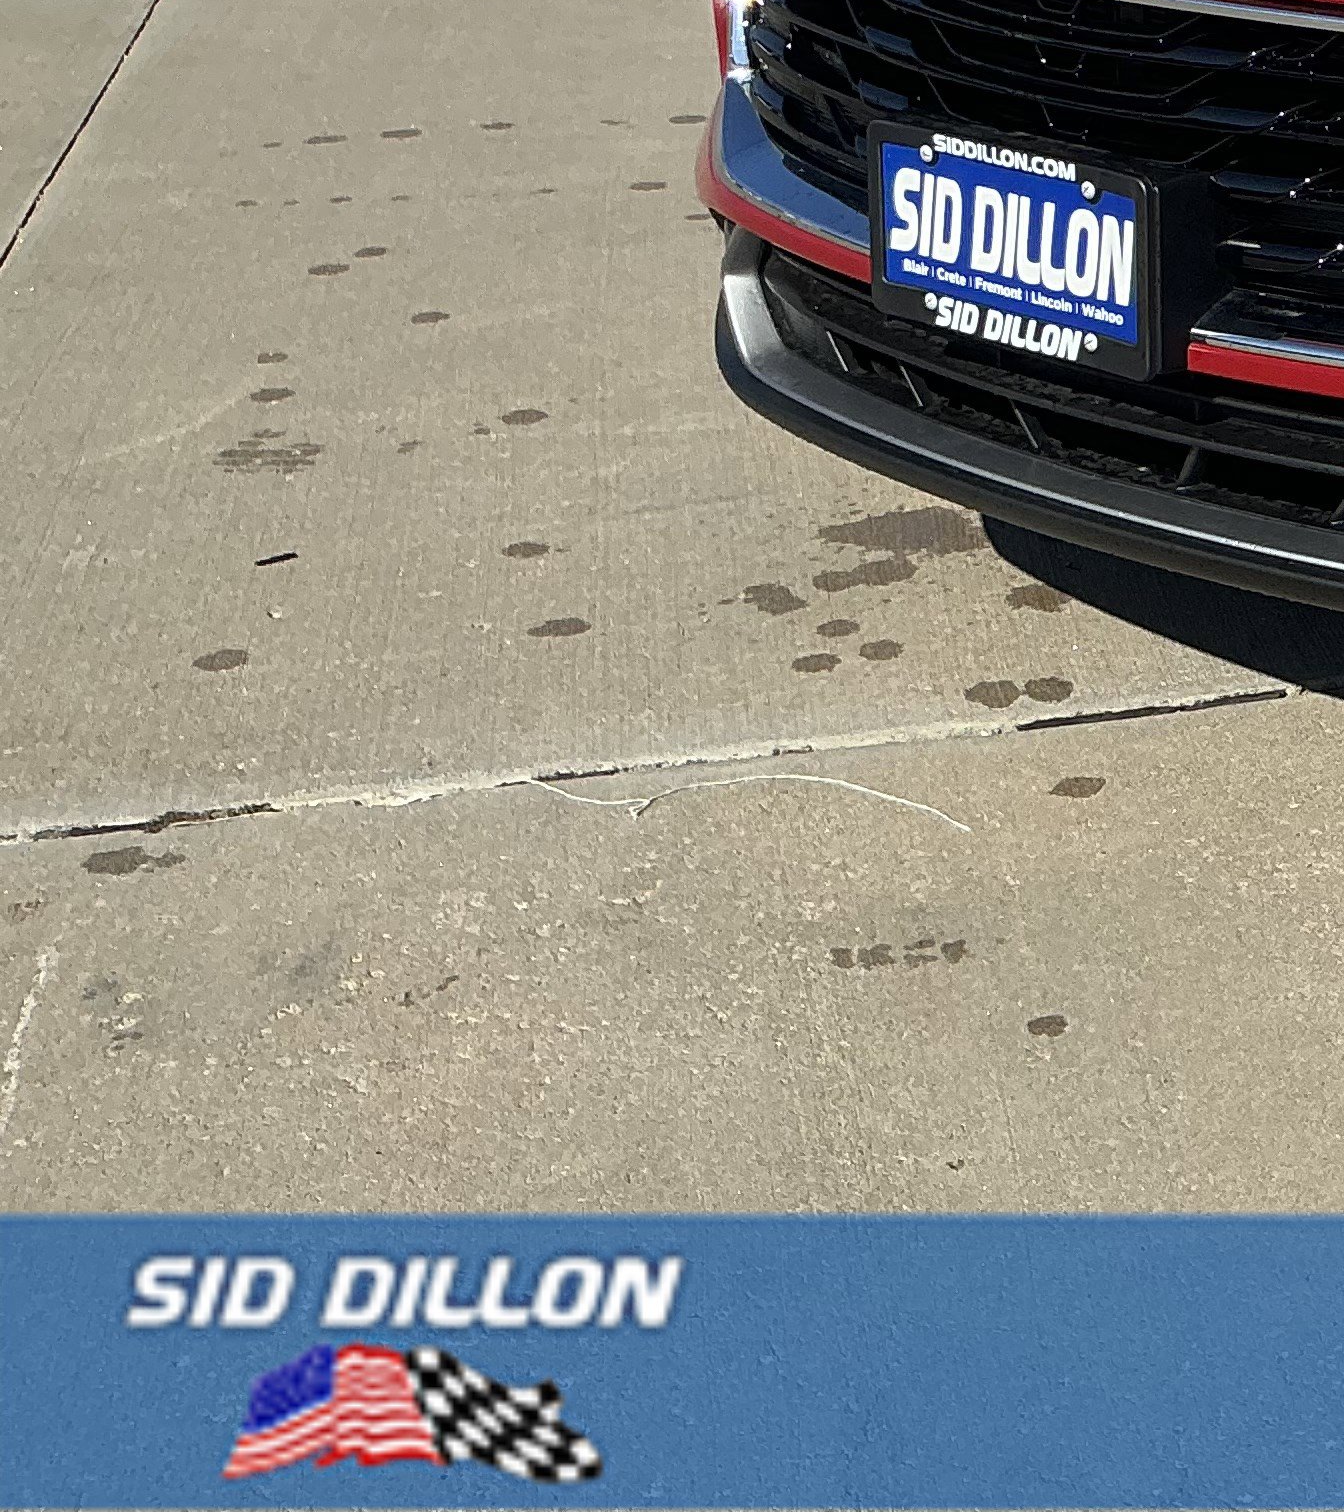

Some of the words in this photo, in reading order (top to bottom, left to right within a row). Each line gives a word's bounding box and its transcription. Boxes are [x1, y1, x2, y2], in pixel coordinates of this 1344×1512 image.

[933, 134, 1076, 181] SIDDILLON.COM
[889, 167, 963, 264] SID
[970, 185, 1135, 307] DILLON
[902, 258, 930, 277] Blair
[936, 267, 967, 287] Crete
[975, 276, 1023, 301] Fremont
[1030, 290, 1073, 313] Lincoln
[1082, 303, 1124, 326] Wahoo
[934, 296, 980, 335] SID
[983, 309, 1082, 360] DILLON
